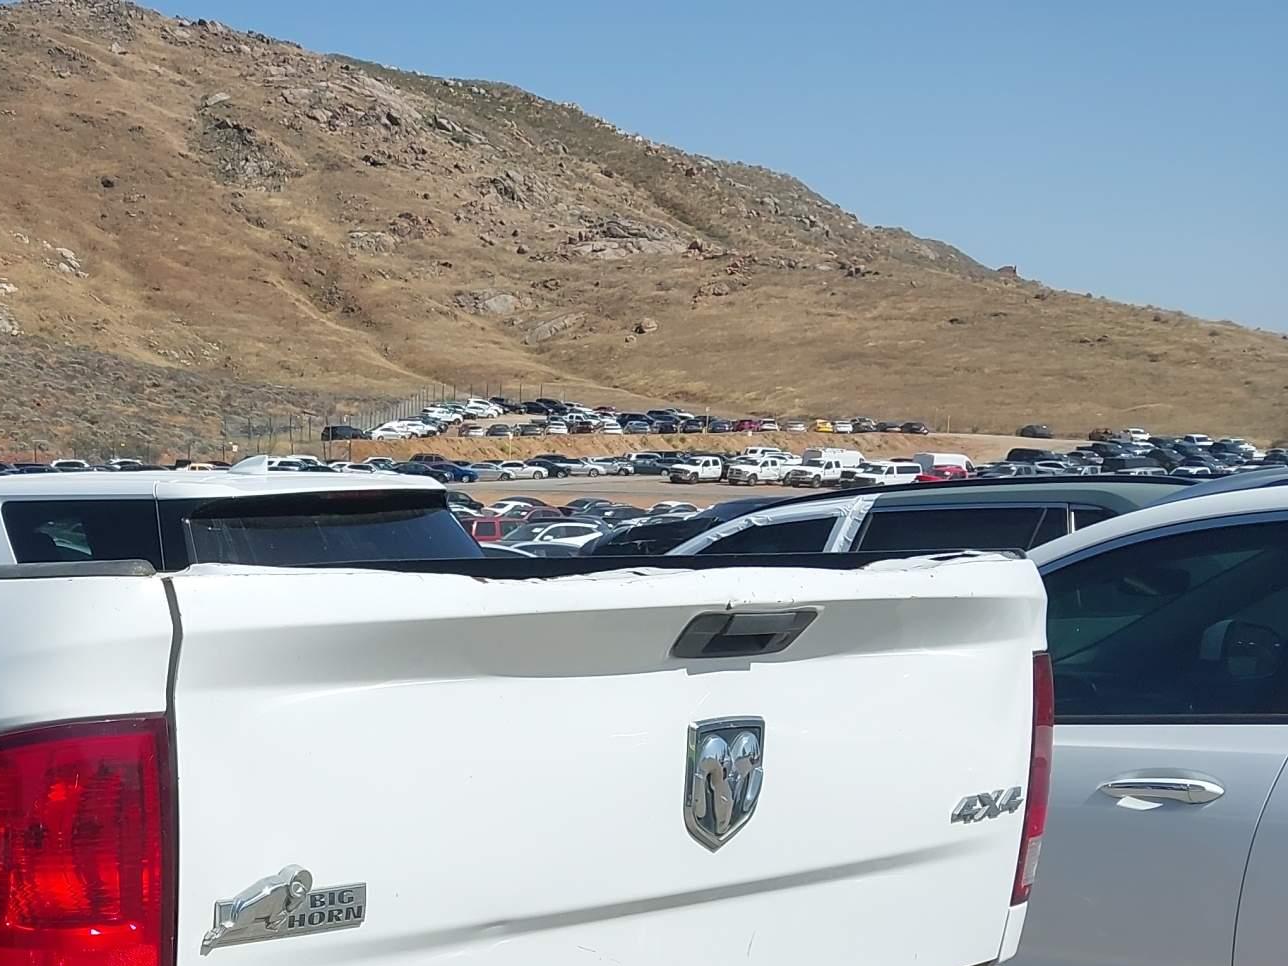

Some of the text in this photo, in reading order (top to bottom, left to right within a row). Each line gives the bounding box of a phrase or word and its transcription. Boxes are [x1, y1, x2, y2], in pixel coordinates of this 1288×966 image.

[951, 786, 1024, 824] 4X4
[310, 890, 354, 907] BIG
[288, 906, 363, 929] HORN
